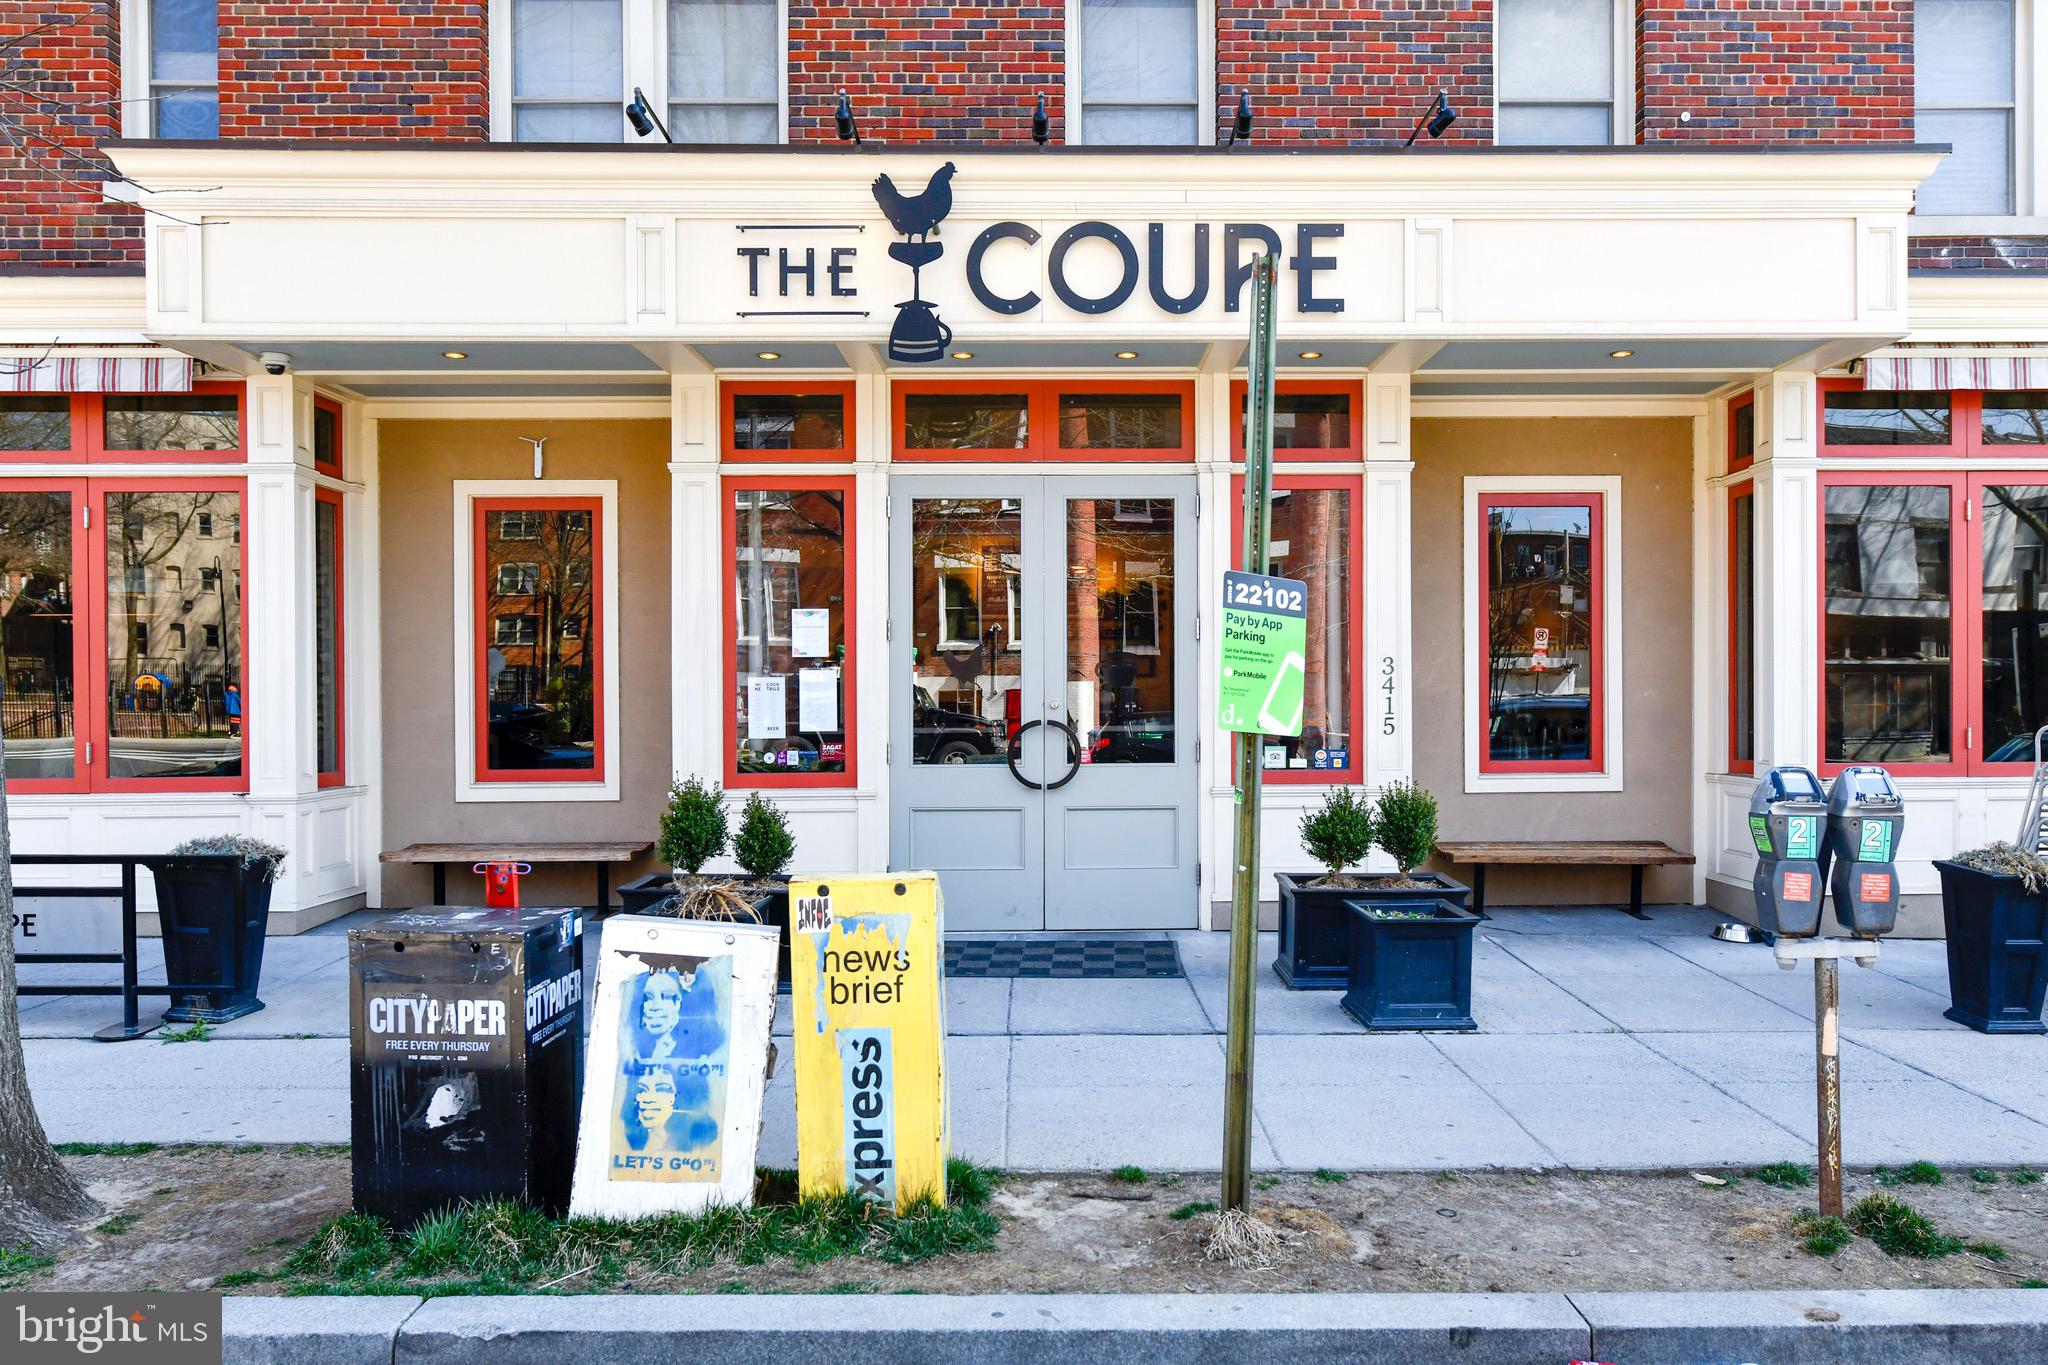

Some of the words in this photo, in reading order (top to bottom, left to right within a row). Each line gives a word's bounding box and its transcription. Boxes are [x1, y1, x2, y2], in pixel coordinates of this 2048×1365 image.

[736, 247, 857, 297] THE
[965, 221, 1345, 315] COUPE
[1235, 583, 1302, 612] 22102
[1226, 613, 1246, 628] Pay
[1248, 615, 1260, 630] by
[1262, 617, 1283, 632] App
[1226, 628, 1266, 645] Parking
[1233, 670, 1267, 680] ParkMobile
[1382, 656, 1395, 735] 3415
[1790, 817, 1808, 843] 2
[1864, 821, 1883, 847] 2
[823, 950, 910, 972] news
[527, 968, 582, 1031] CITYPAPER
[831, 974, 903, 1004] brief
[369, 997, 506, 1036] CITYPAPER
[385, 1039, 408, 1050] FREE
[410, 1040, 440, 1050] EVERY
[440, 1041, 490, 1052] THURSDAY
[613, 1154, 663, 1170] LET'S
